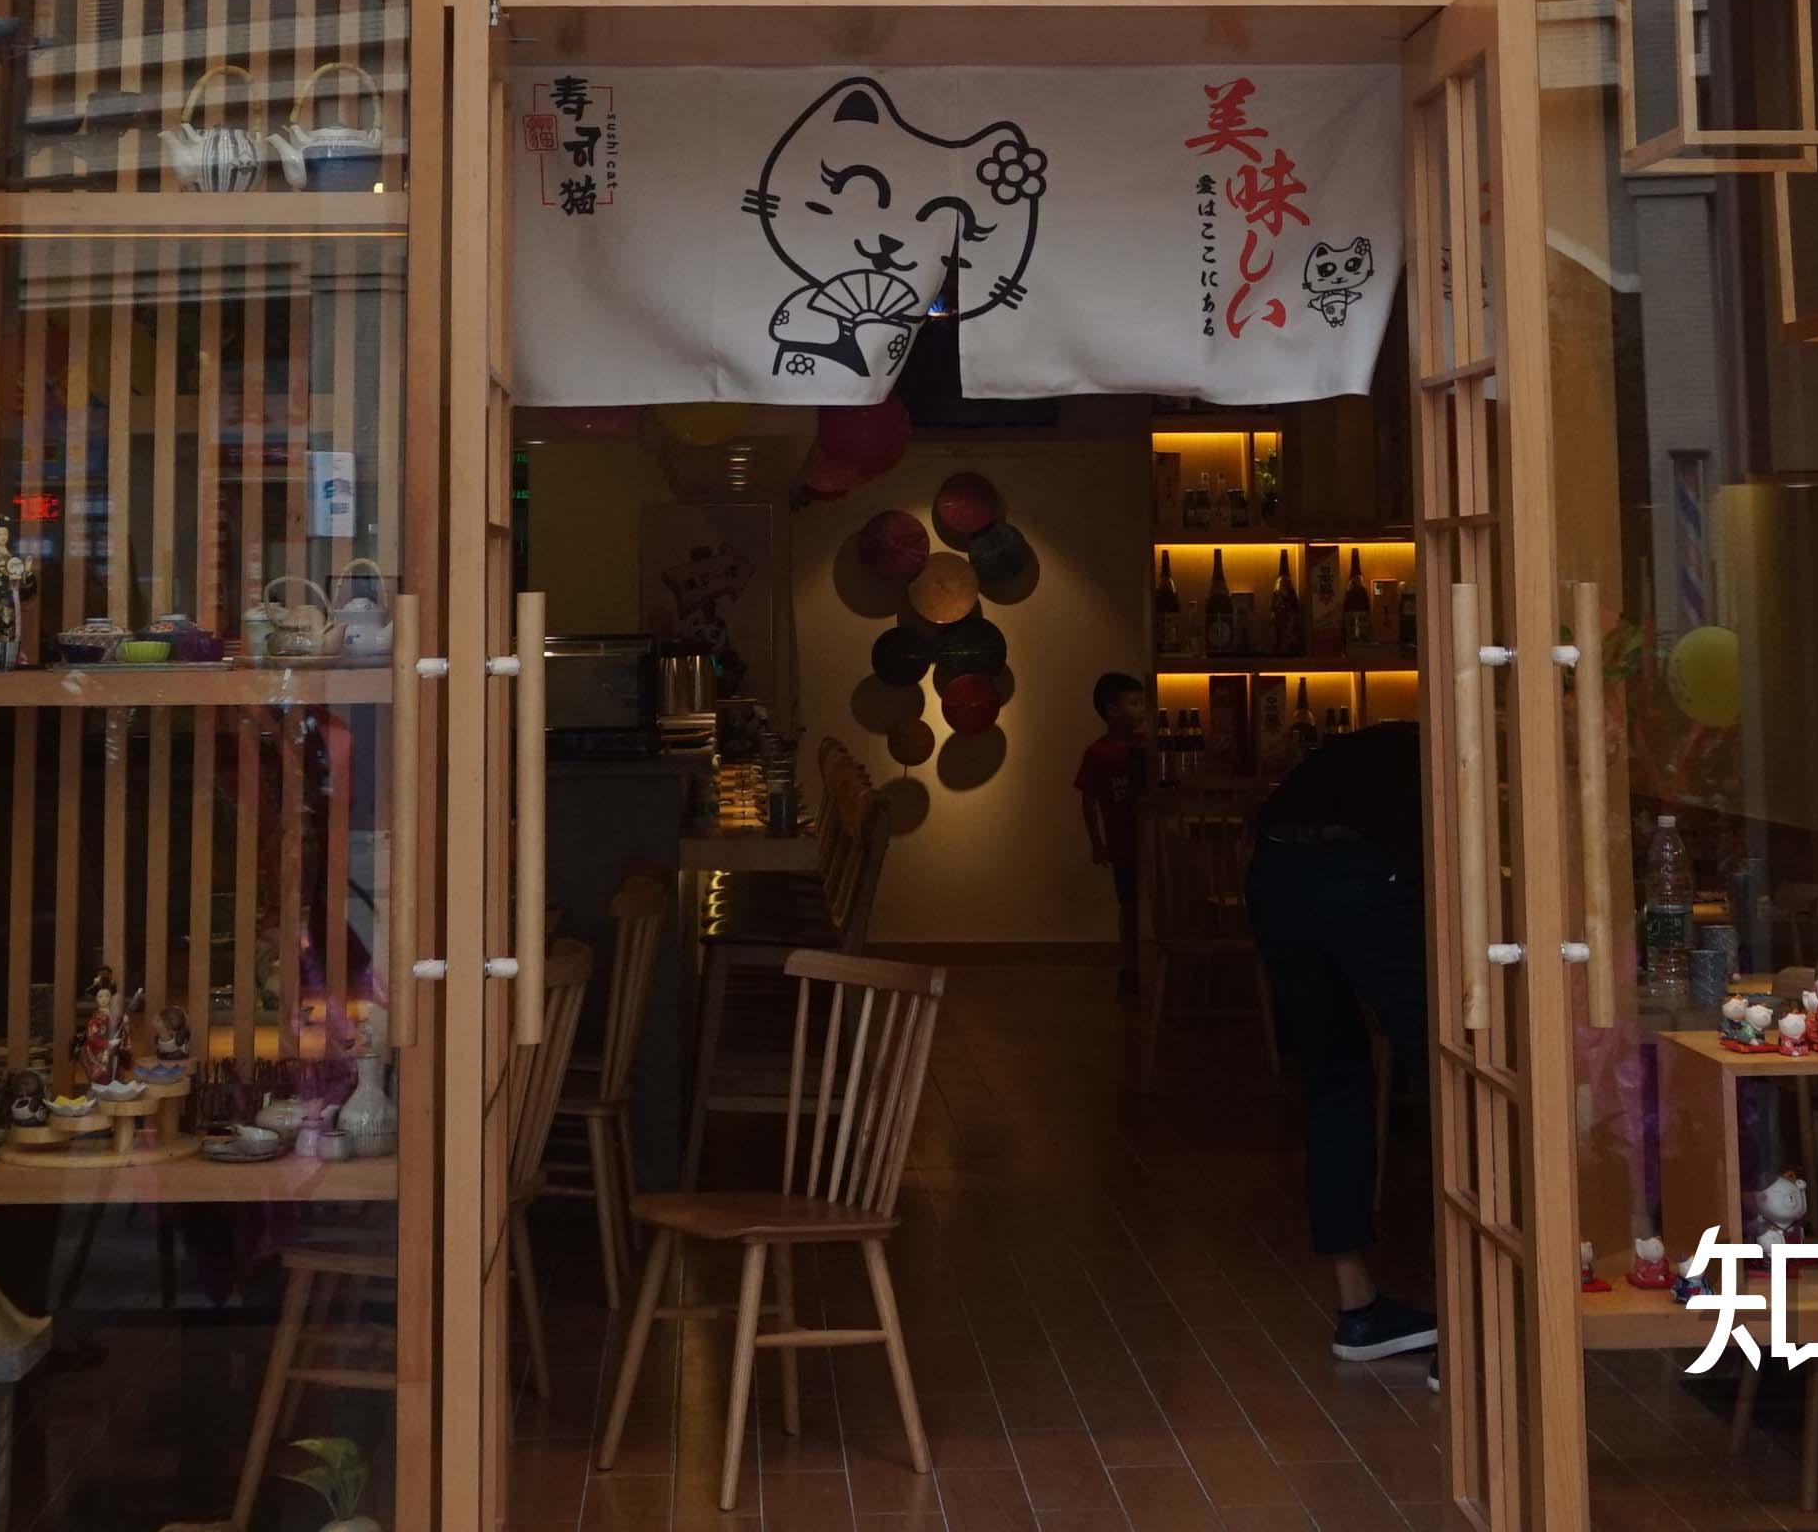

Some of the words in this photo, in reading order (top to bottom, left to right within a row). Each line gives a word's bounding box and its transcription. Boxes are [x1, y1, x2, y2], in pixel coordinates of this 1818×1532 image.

[549, 74, 602, 216] 寿司猫
[606, 113, 620, 156] sushi
[606, 160, 619, 189] cat
[1184, 77, 1311, 339] 美味しい
